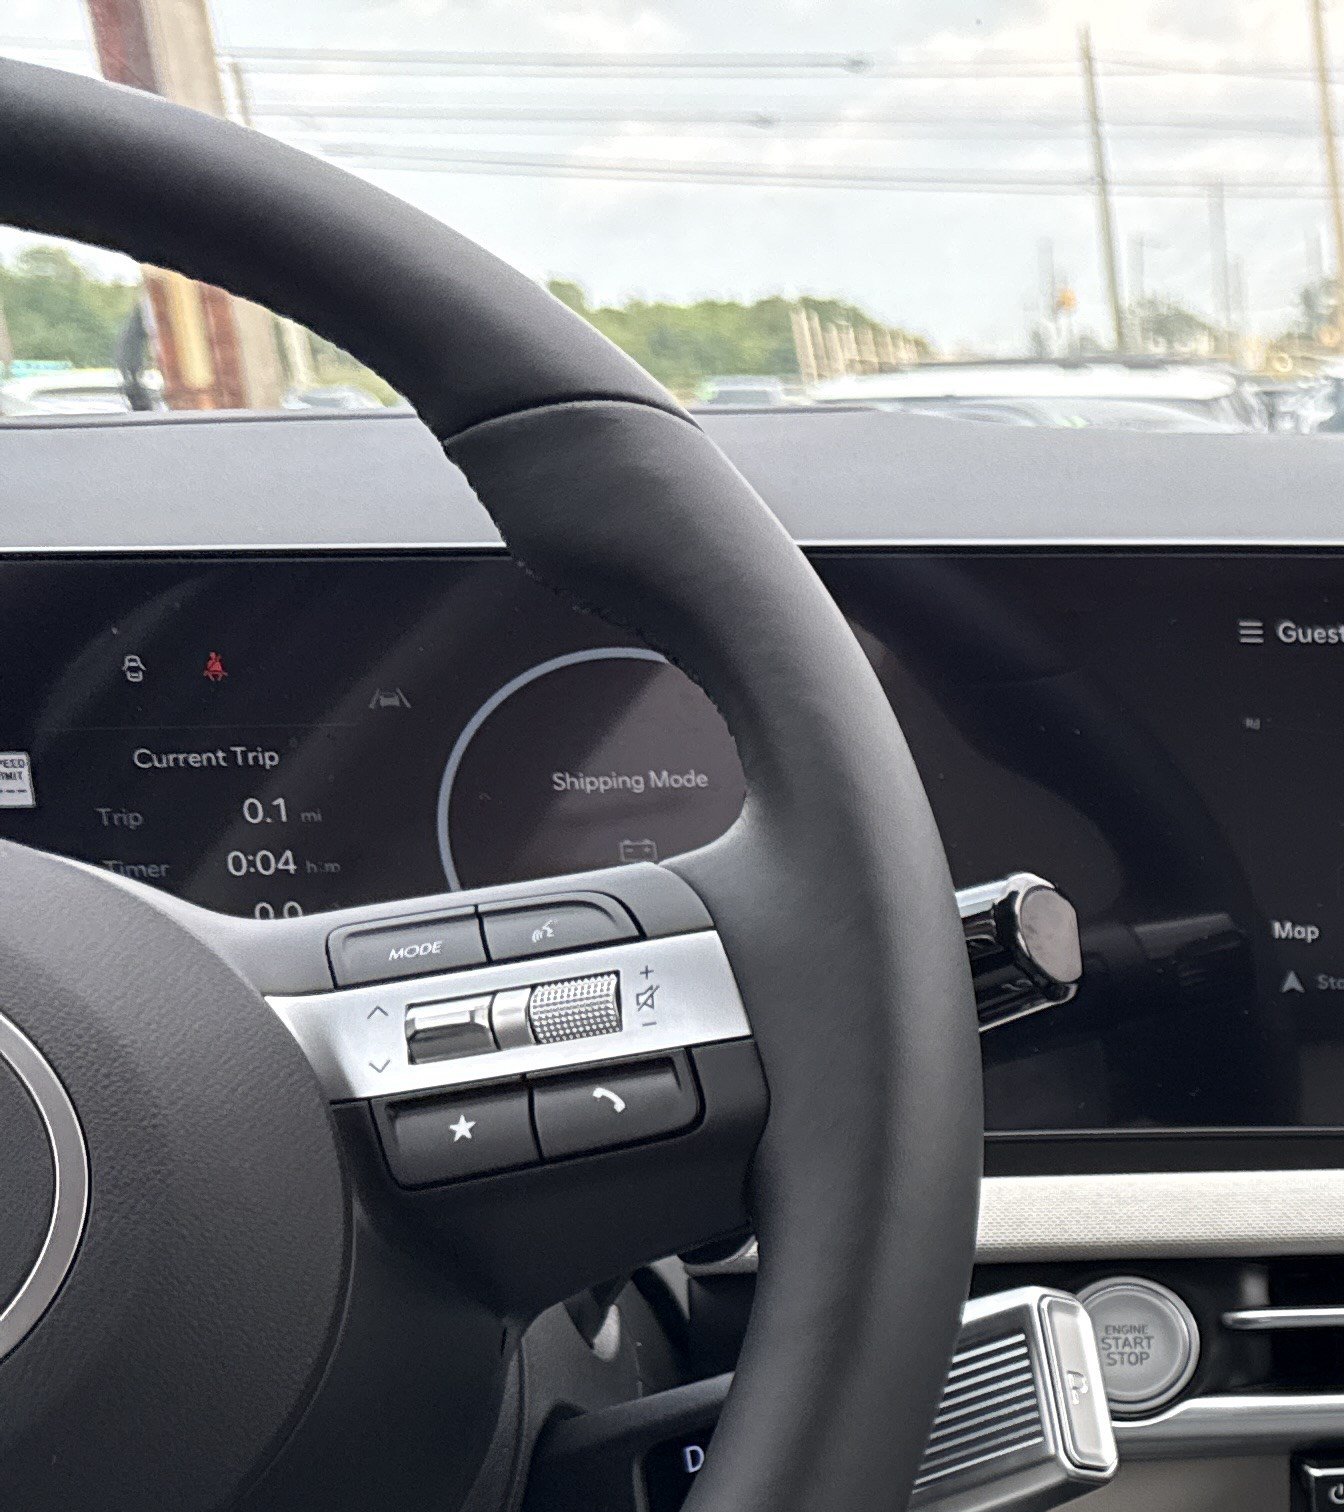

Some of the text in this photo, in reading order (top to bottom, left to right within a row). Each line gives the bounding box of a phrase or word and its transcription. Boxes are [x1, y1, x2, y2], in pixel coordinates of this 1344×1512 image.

[133, 746, 279, 769] Current Trip
[552, 769, 709, 794] Shipping Mode
[96, 807, 143, 829] Trip
[242, 797, 288, 824] 0.1
[103, 860, 170, 878] Timer
[227, 849, 297, 877] 0:04
[1272, 920, 1320, 943] Map
[389, 940, 442, 961] MODE
[1104, 1324, 1148, 1336] ENGINE
[1101, 1336, 1154, 1351] START
[1106, 1351, 1151, 1367] STOP
[683, 1445, 704, 1473] D
